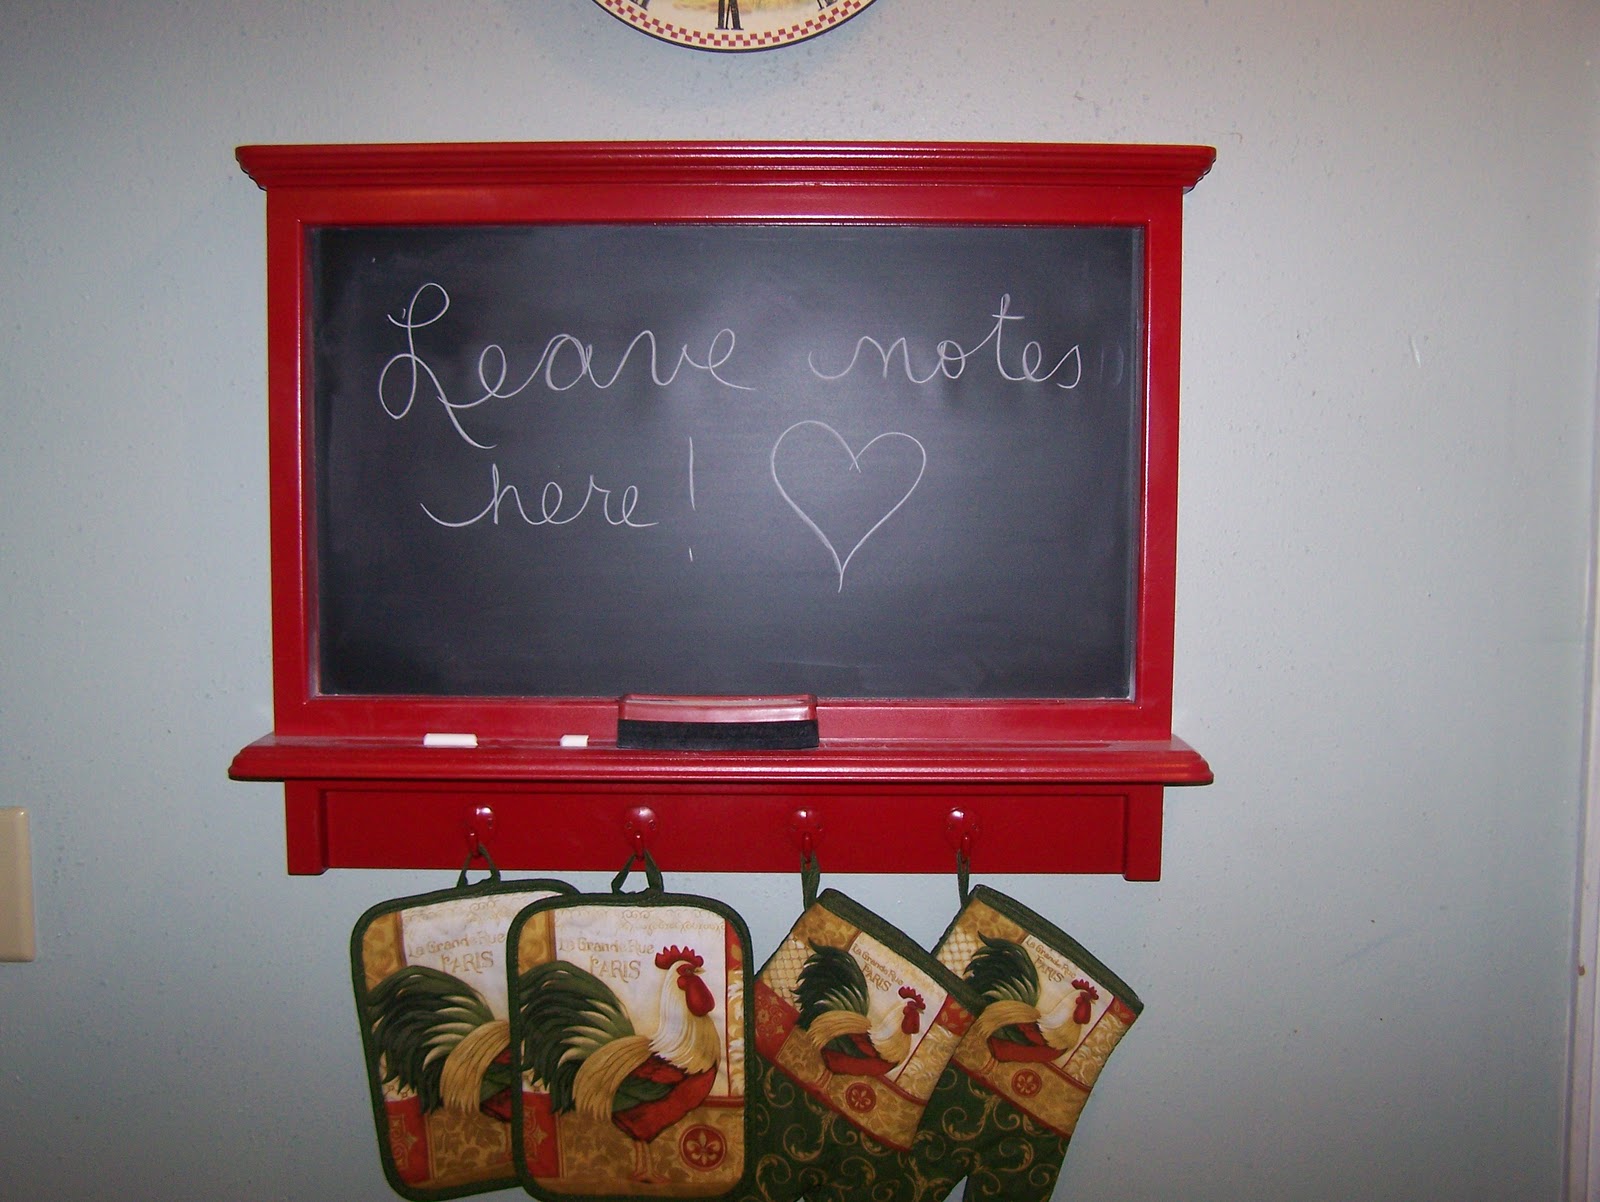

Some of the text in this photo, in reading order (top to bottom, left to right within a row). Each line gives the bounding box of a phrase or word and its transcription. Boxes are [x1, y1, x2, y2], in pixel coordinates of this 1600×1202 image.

[379, 283, 1082, 449] Leave notes
[441, 950, 494, 973] PARIS
[589, 955, 641, 983] PARIS
[1034, 954, 1065, 983] PARIS
[862, 961, 892, 992] PARIS
